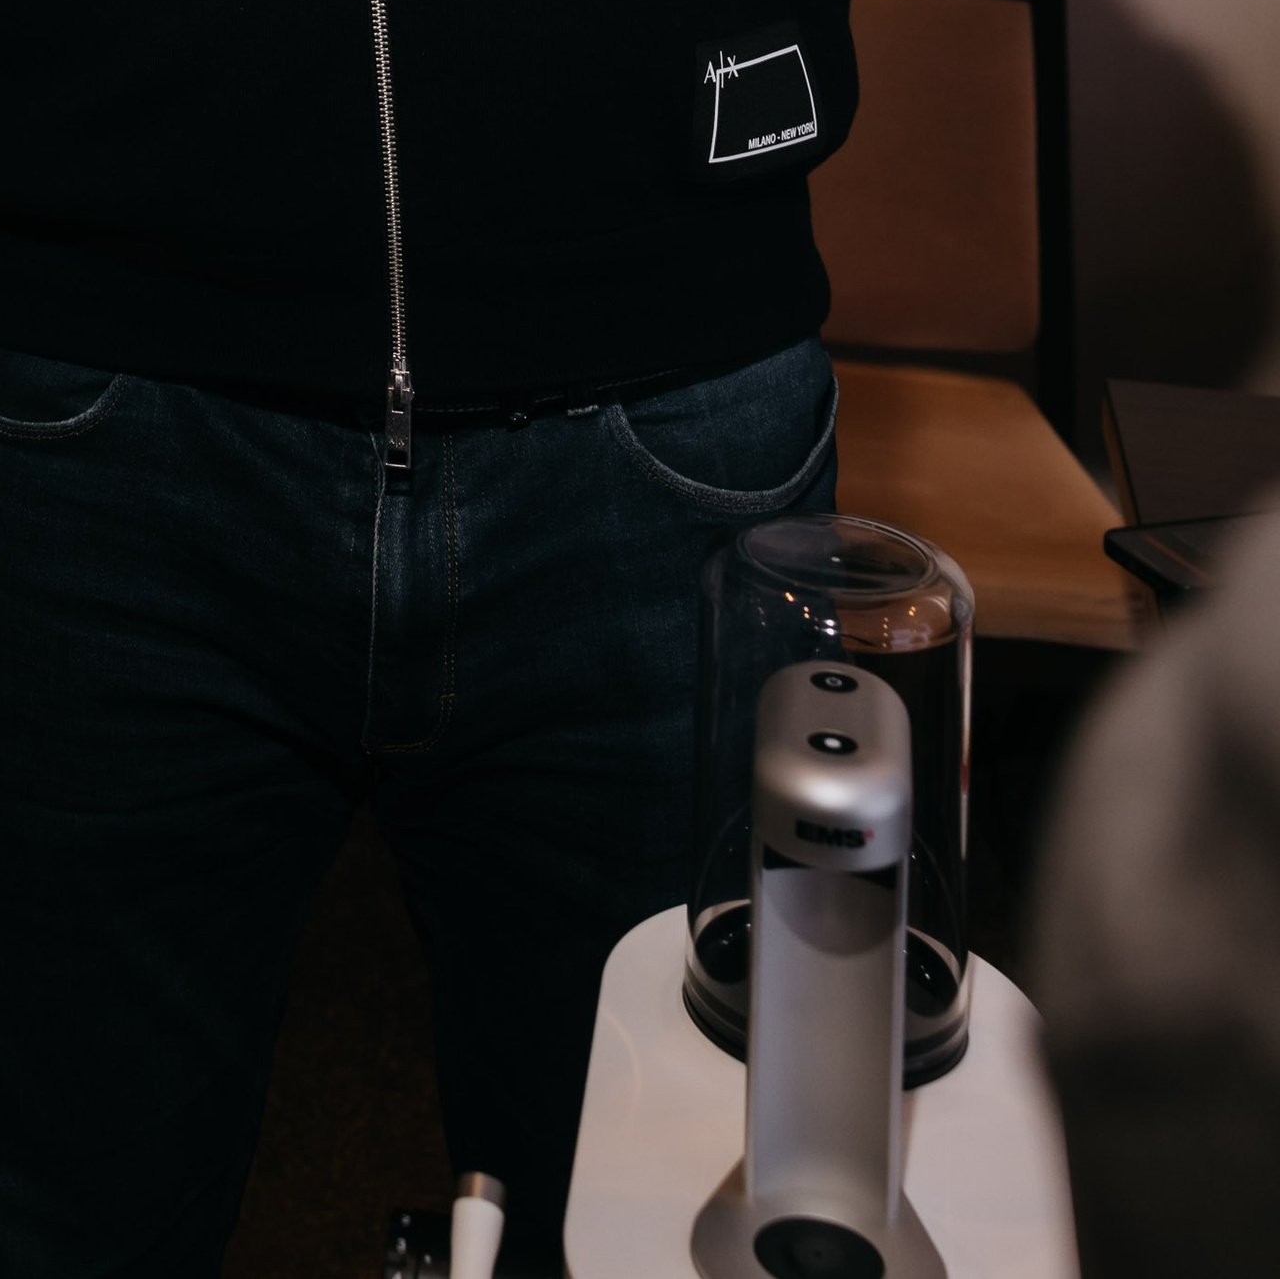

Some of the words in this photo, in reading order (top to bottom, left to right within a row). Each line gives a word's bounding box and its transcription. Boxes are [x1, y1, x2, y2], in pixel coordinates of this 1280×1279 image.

[747, 132, 777, 150] MILANO
[781, 126, 797, 141] NEW
[797, 121, 815, 136] YORK
